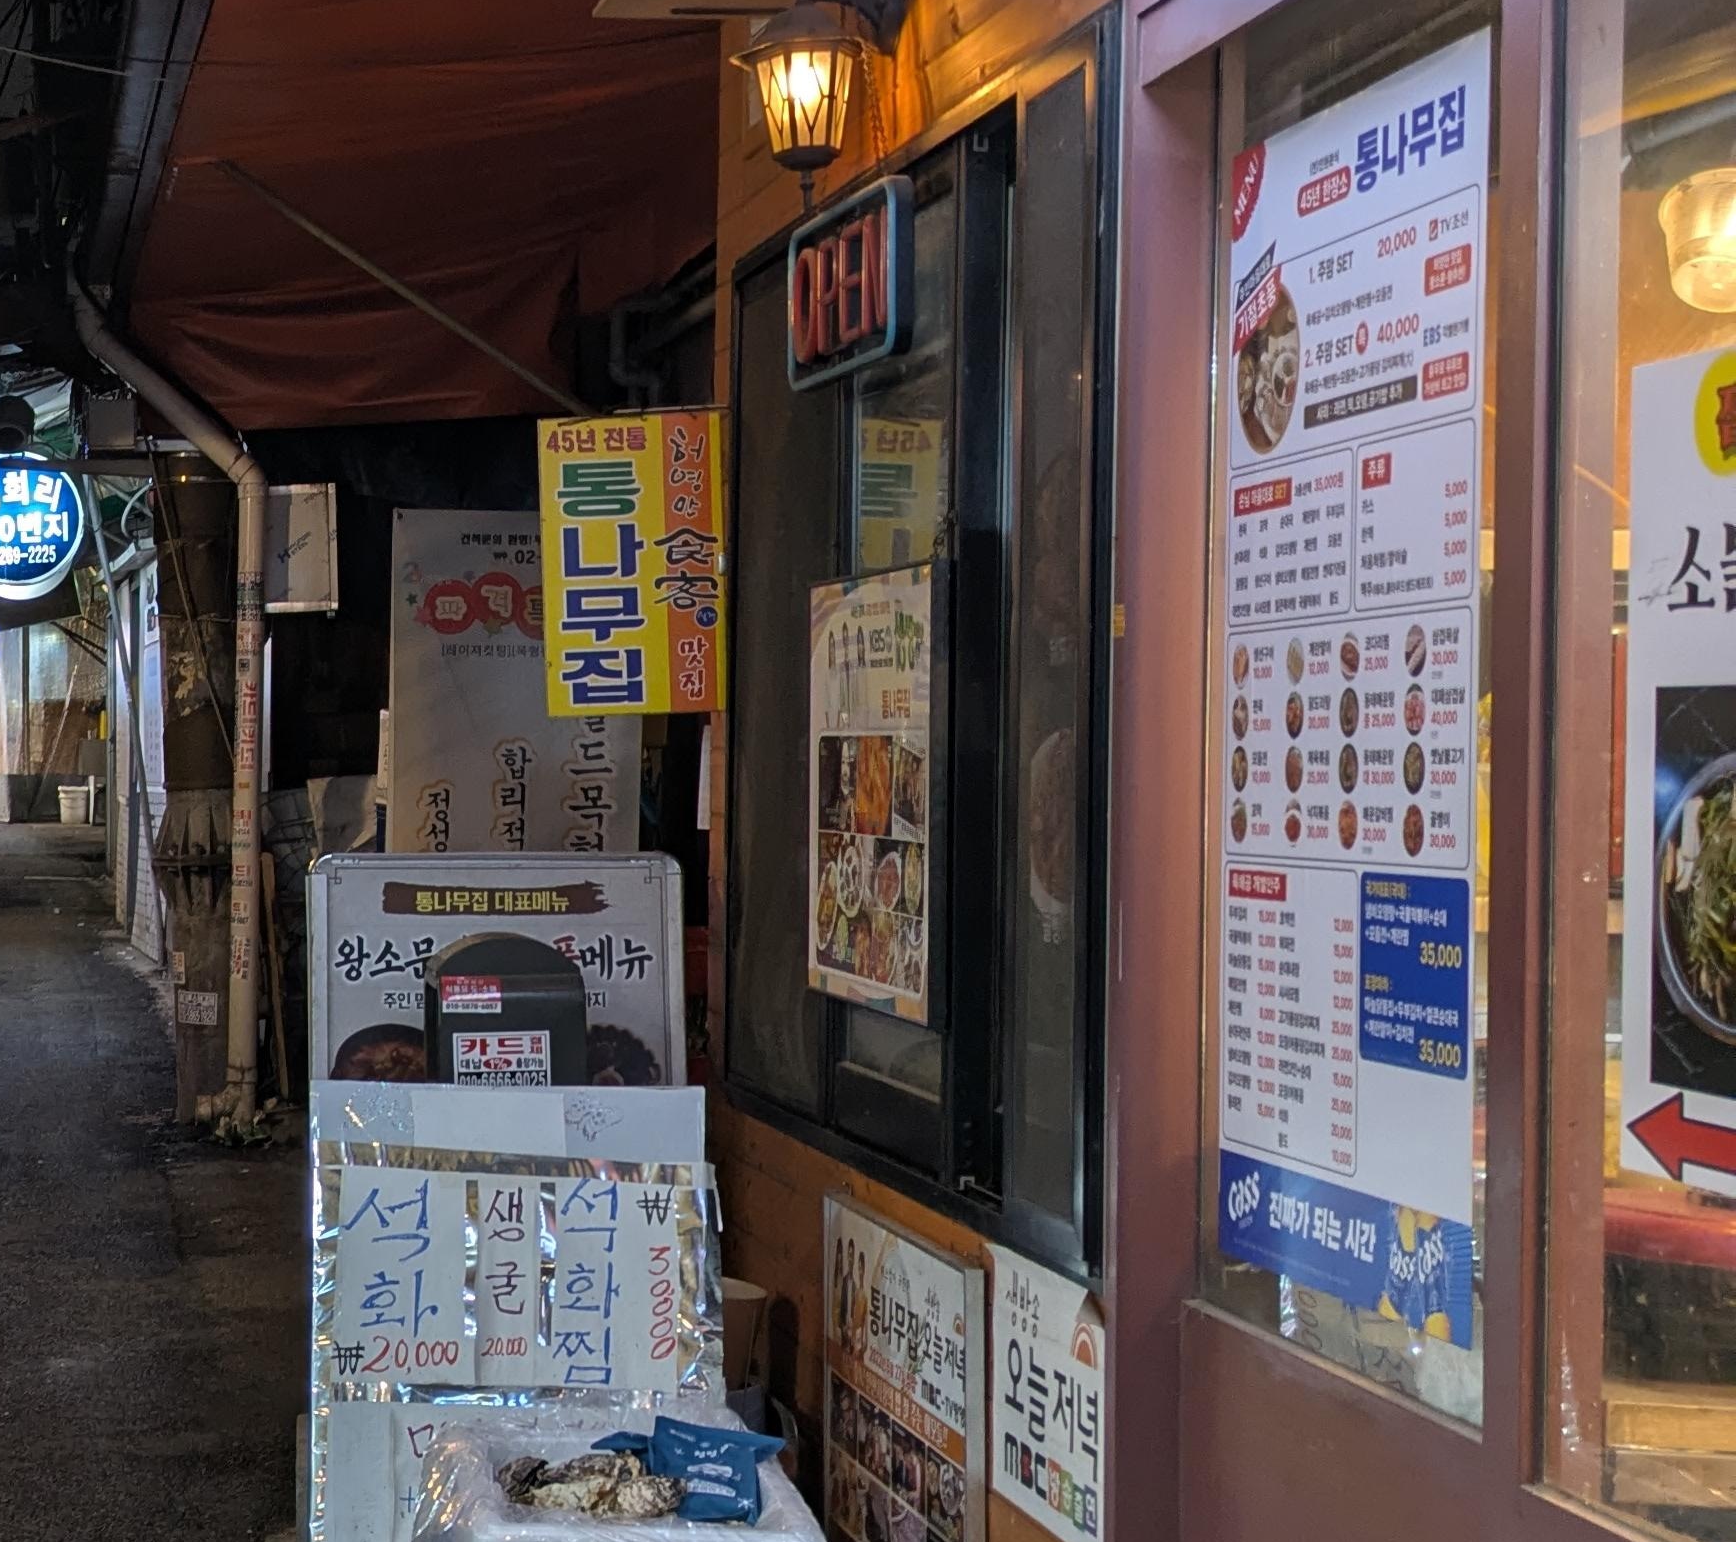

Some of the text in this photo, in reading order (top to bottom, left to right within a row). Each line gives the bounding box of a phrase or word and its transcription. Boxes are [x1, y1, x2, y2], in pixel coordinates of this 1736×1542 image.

[1355, 84, 1466, 194] 통나무집
[1232, 153, 1260, 225] MENU
[1301, 187, 1320, 211] 45년
[1336, 250, 1354, 275] SET
[1377, 226, 1417, 259] 20,000
[794, 204, 888, 364] OPEN
[1335, 334, 1354, 359] SET
[1376, 313, 1420, 344] 40,000
[1423, 323, 1442, 348] EBS
[546, 426, 648, 455] 45년 전통
[669, 426, 705, 519] 허영만
[1444, 479, 1468, 499] 5,000
[1444, 510, 1468, 529] 5,000
[1444, 539, 1467, 558] 5,000
[556, 460, 647, 706] 통나무집
[1444, 569, 1467, 588] 5,000
[679, 635, 708, 700] 맛집
[1430, 710, 1458, 726] 40,000
[1430, 770, 1457, 786] 30,000
[415, 889, 570, 913] 통나무집 대표메뉴
[1420, 940, 1463, 970] 35,000
[383, 992, 411, 1008] 주인
[460, 1037, 524, 1056] 카드
[489, 1059, 507, 1069] 1%
[1419, 1038, 1462, 1069] 35,000
[1269, 1191, 1311, 1239] 진짜가
[1313, 1206, 1343, 1252] 되는
[1344, 1217, 1377, 1264] 시간
[341, 1178, 439, 1338] 석화
[485, 1185, 527, 1316] 생굴
[553, 1177, 621, 1385] 석화찜
[869, 1285, 919, 1361] 통나무집
[1005, 1269, 1040, 1340] 생방송
[1004, 1431, 1047, 1501] MBC
